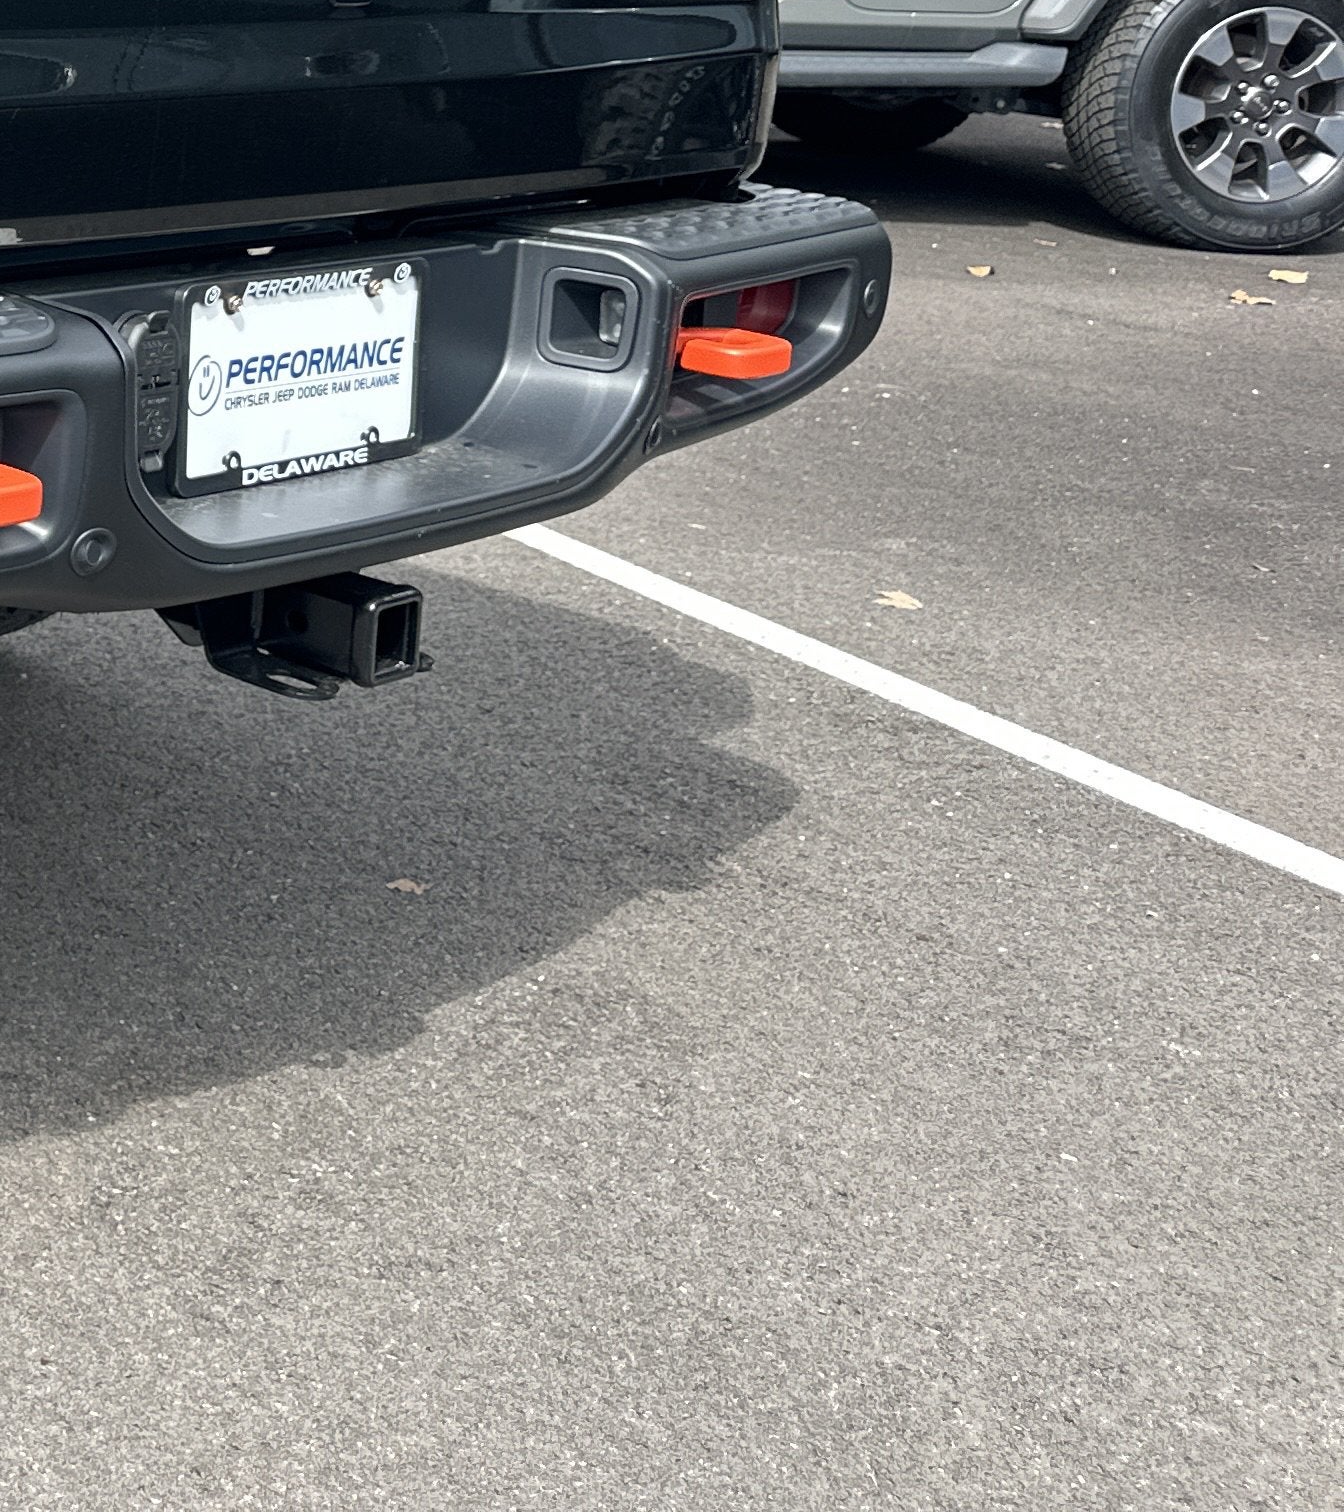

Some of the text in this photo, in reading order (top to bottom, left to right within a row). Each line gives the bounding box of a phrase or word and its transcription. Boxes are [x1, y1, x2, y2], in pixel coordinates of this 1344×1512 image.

[243, 268, 373, 300] PERFORMANCE
[225, 336, 405, 389] PERFORMANCE
[224, 373, 400, 410] CHRYSLER JEEP DODGE RAM DELAWARE
[241, 447, 368, 486] DELAWARE
